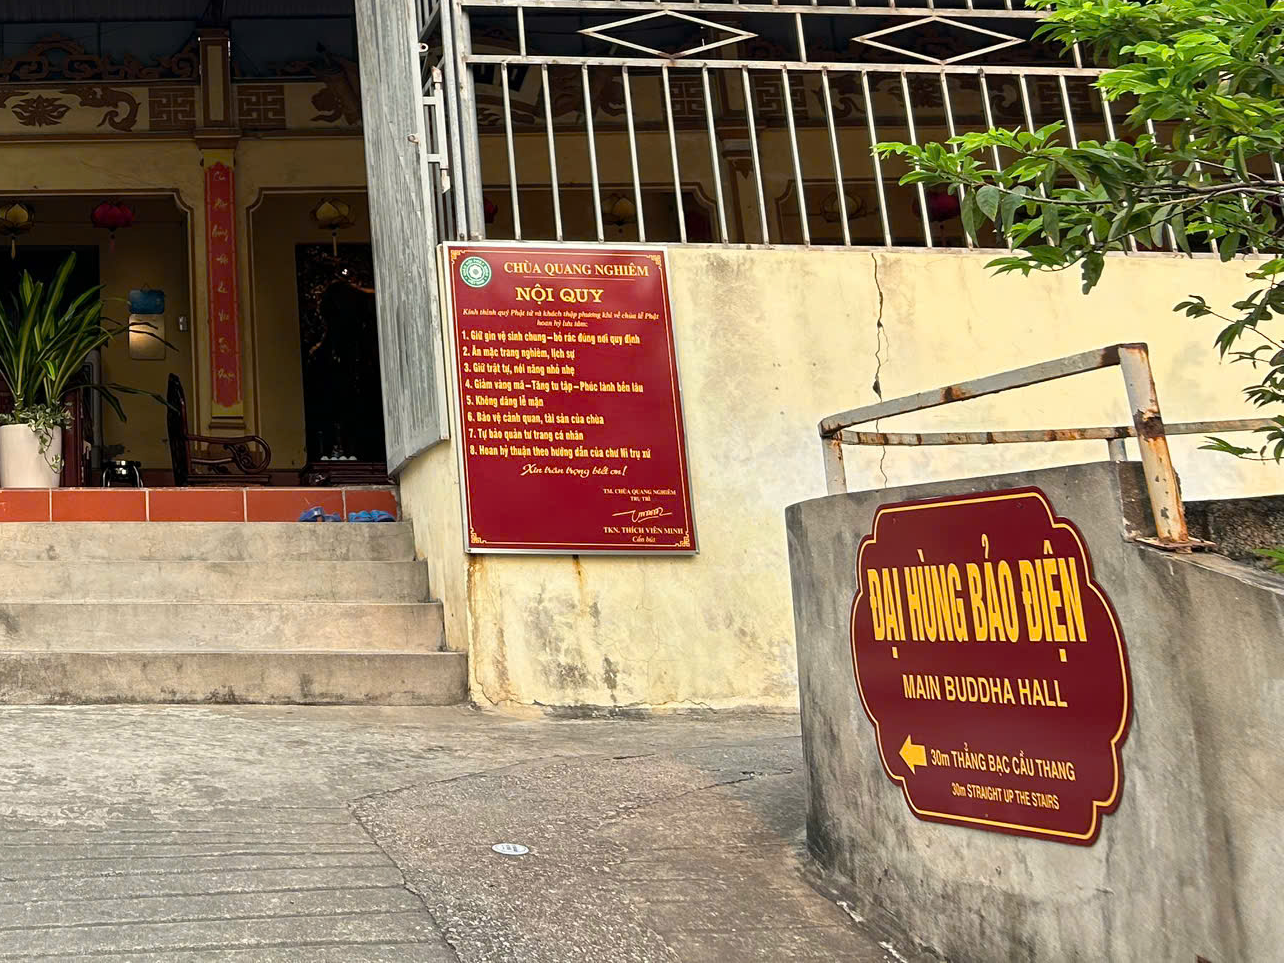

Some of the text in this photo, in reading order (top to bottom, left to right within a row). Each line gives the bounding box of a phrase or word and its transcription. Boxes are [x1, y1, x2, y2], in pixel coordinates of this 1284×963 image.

[504, 260, 541, 274] CHÙA
[544, 262, 591, 276] QUANG
[594, 262, 649, 277] NGHIÊM
[516, 283, 604, 305] NỘI QUY
[867, 533, 1088, 663] ĐẠI HÙNG BẢO ĐIỆN
[902, 674, 1068, 708] MAIN BUDDHA HALL
[930, 748, 951, 767] 30m
[988, 754, 1010, 777] BẠC
[1012, 749, 1035, 777] CẦU
[1035, 759, 1076, 782] THANG
[951, 782, 1060, 810] 30m STRAIGHT UP THE STAIRS
